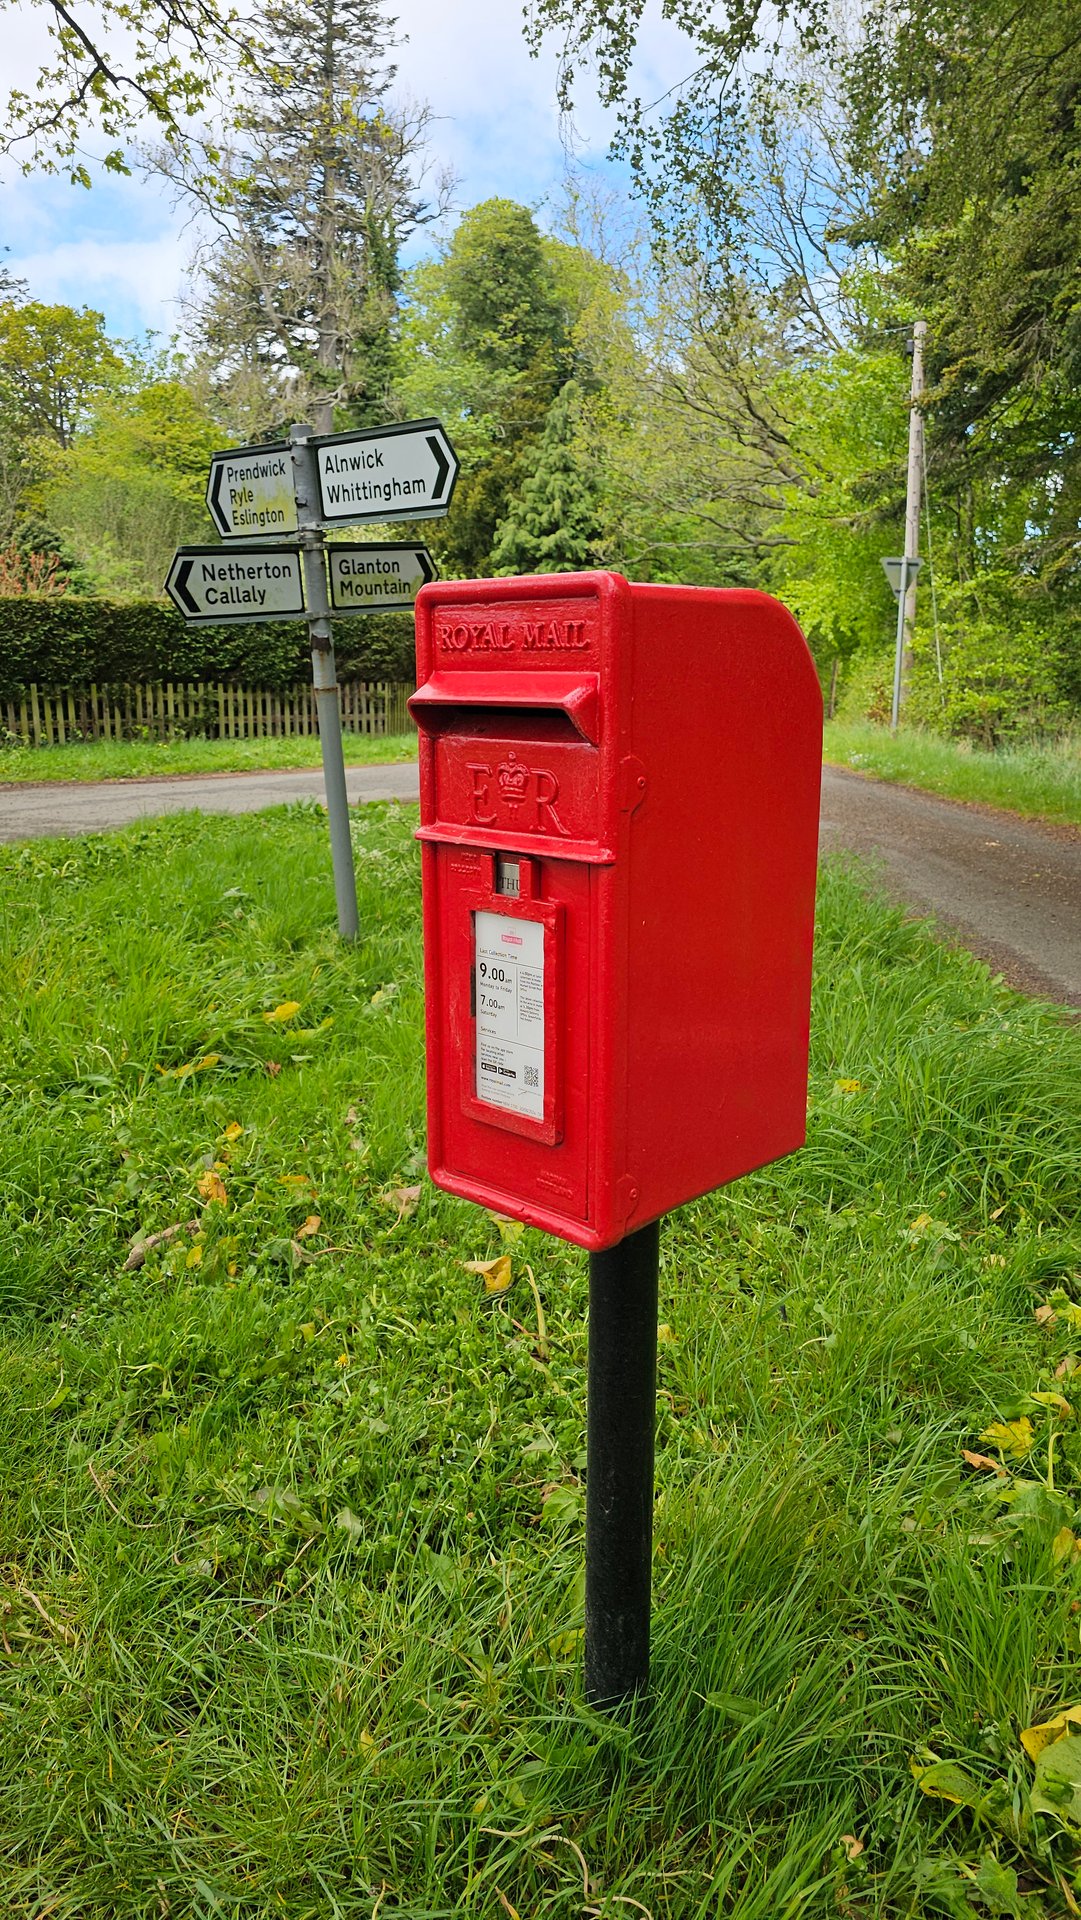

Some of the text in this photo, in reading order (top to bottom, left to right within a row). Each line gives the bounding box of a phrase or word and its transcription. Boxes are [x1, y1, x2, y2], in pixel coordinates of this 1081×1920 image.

[324, 448, 385, 474] Alnwick
[226, 459, 286, 483] Prendwick
[229, 487, 254, 505] Ryle
[326, 477, 426, 504] Whittingham
[232, 508, 285, 527] Eslington
[201, 561, 292, 582] Netherton
[338, 558, 400, 576] Glanton
[205, 585, 266, 606] Callaly
[340, 578, 411, 598] Mountain
[438, 619, 591, 651] ROYAL MAIL
[488, 950, 507, 958] Collection
[500, 986, 512, 994] Friday
[480, 1009, 497, 1018] Saturday
[480, 1026, 496, 1034] Services
